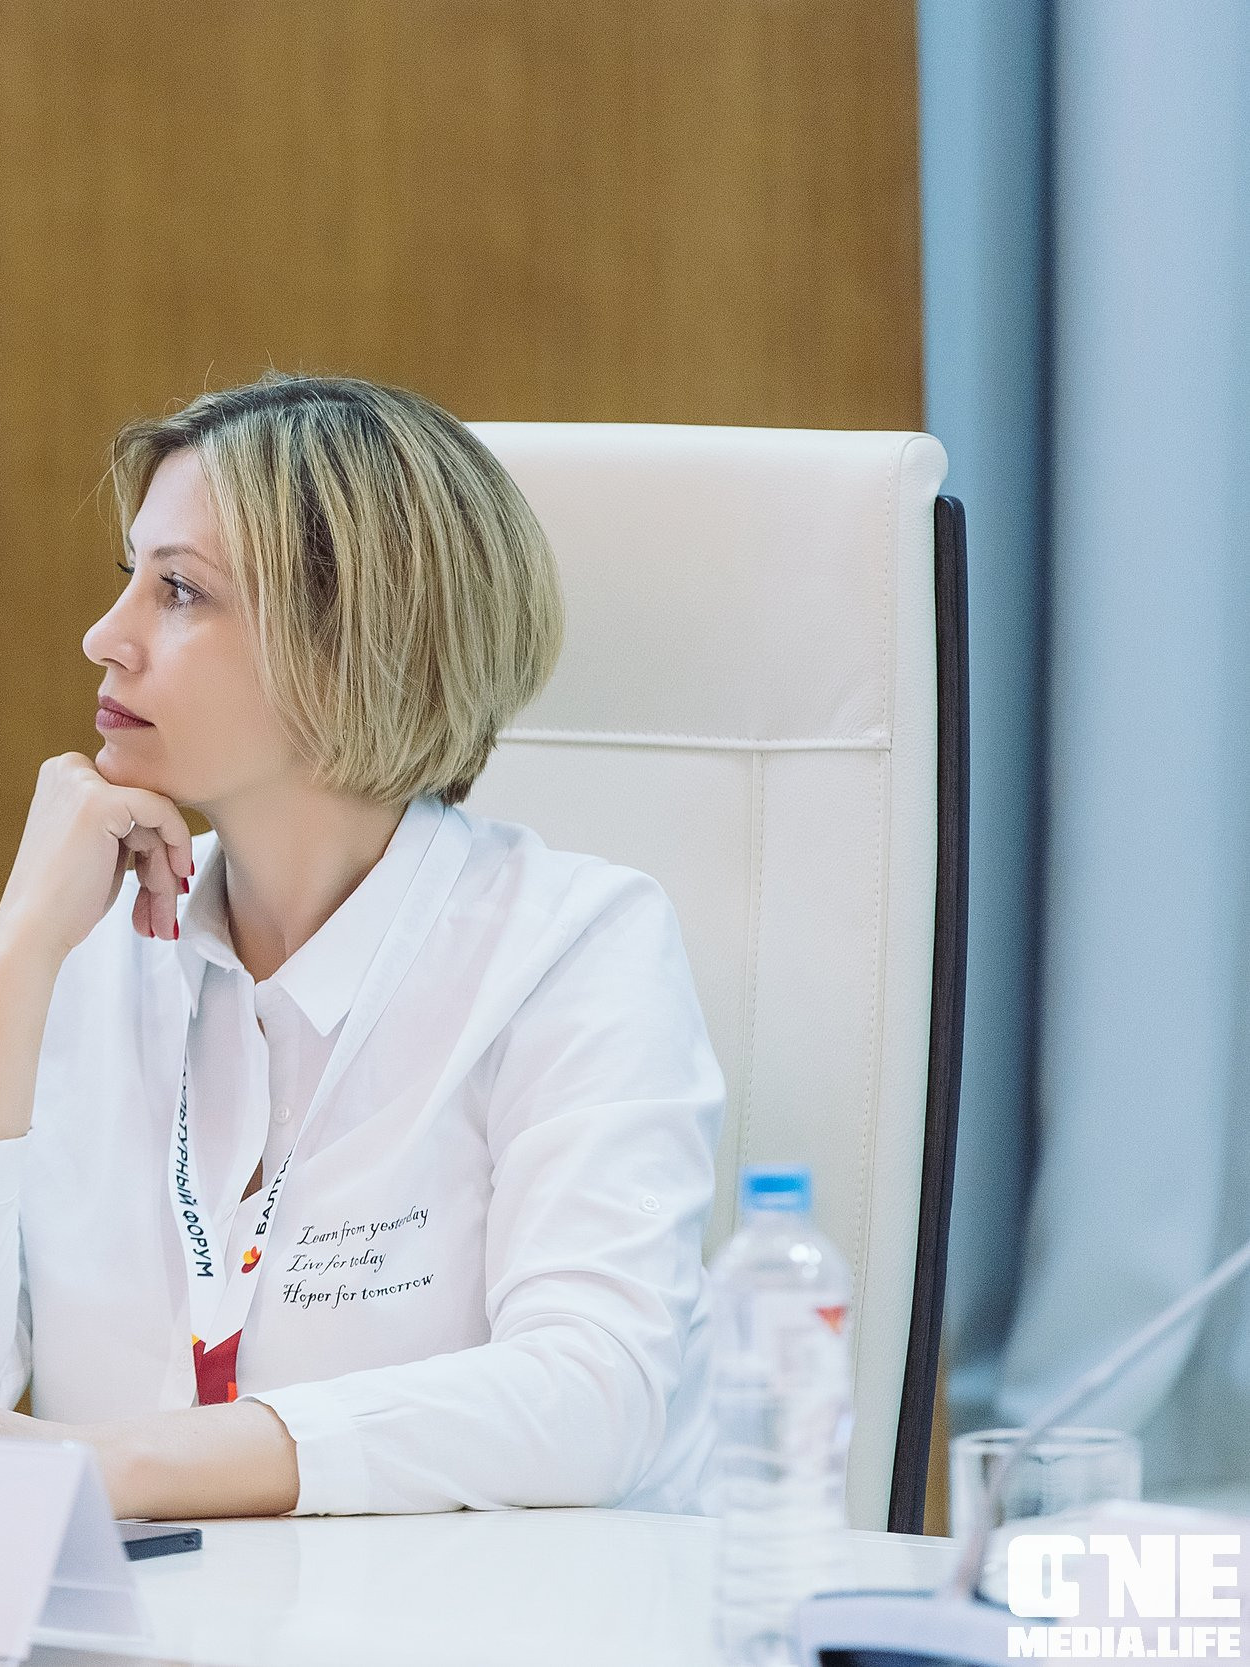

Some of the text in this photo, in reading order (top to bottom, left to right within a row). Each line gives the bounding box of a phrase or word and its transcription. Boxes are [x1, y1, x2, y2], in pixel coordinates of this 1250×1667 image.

[182, 1210, 214, 1278] ФОРУМ
[297, 1205, 429, 1246] Learn from yesterday
[286, 1249, 386, 1276] Live for today
[283, 1273, 434, 1310] Hoper for tomorrow
